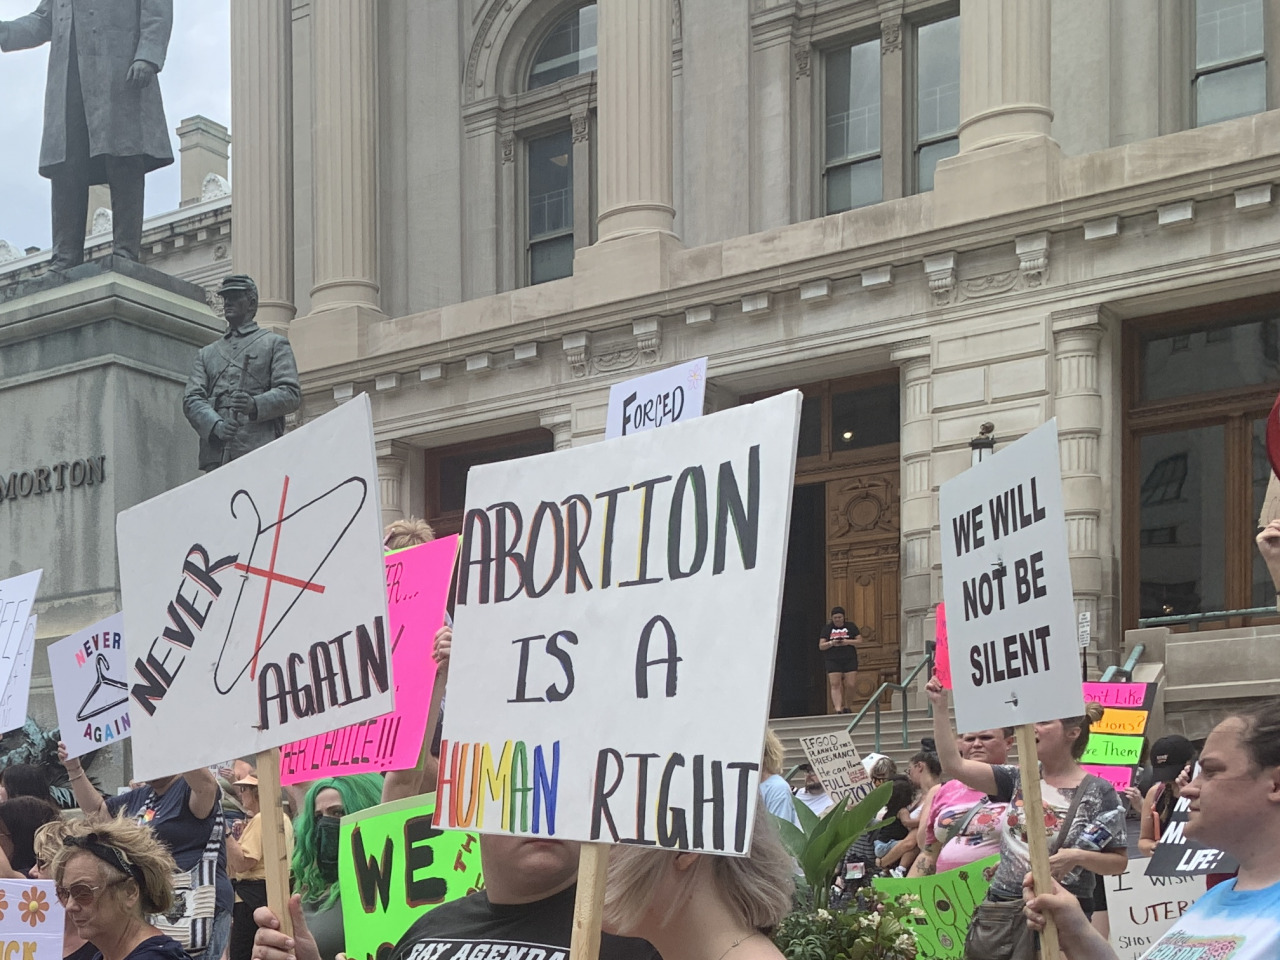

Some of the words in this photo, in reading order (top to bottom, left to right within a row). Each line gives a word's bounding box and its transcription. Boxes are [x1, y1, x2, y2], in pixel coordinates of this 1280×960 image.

[622, 385, 684, 436] FORCED
[458, 443, 761, 606] ABORTION
[952, 503, 985, 557] WE
[989, 476, 1046, 541] WILL
[962, 565, 1007, 622] NOT
[1016, 550, 1048, 604] BE
[74, 630, 121, 669] NEVER
[130, 542, 239, 717] NEVER
[257, 615, 390, 731] AGAIN
[507, 629, 579, 703] IS
[635, 614, 682, 699] A
[969, 625, 1052, 687] SILENT
[1084, 690, 1110, 704] on't
[84, 711, 131, 744] AGAIN
[816, 735, 838, 747] GOD
[1103, 740, 1138, 759] Them
[433, 739, 561, 836] HUMAN
[589, 747, 760, 855] RIGHT
[822, 776, 850, 791] FULL
[351, 814, 448, 914] WE
[1112, 872, 1133, 892] I
[1175, 848, 1225, 872] LIFE!
[1129, 899, 1193, 925] UTER
